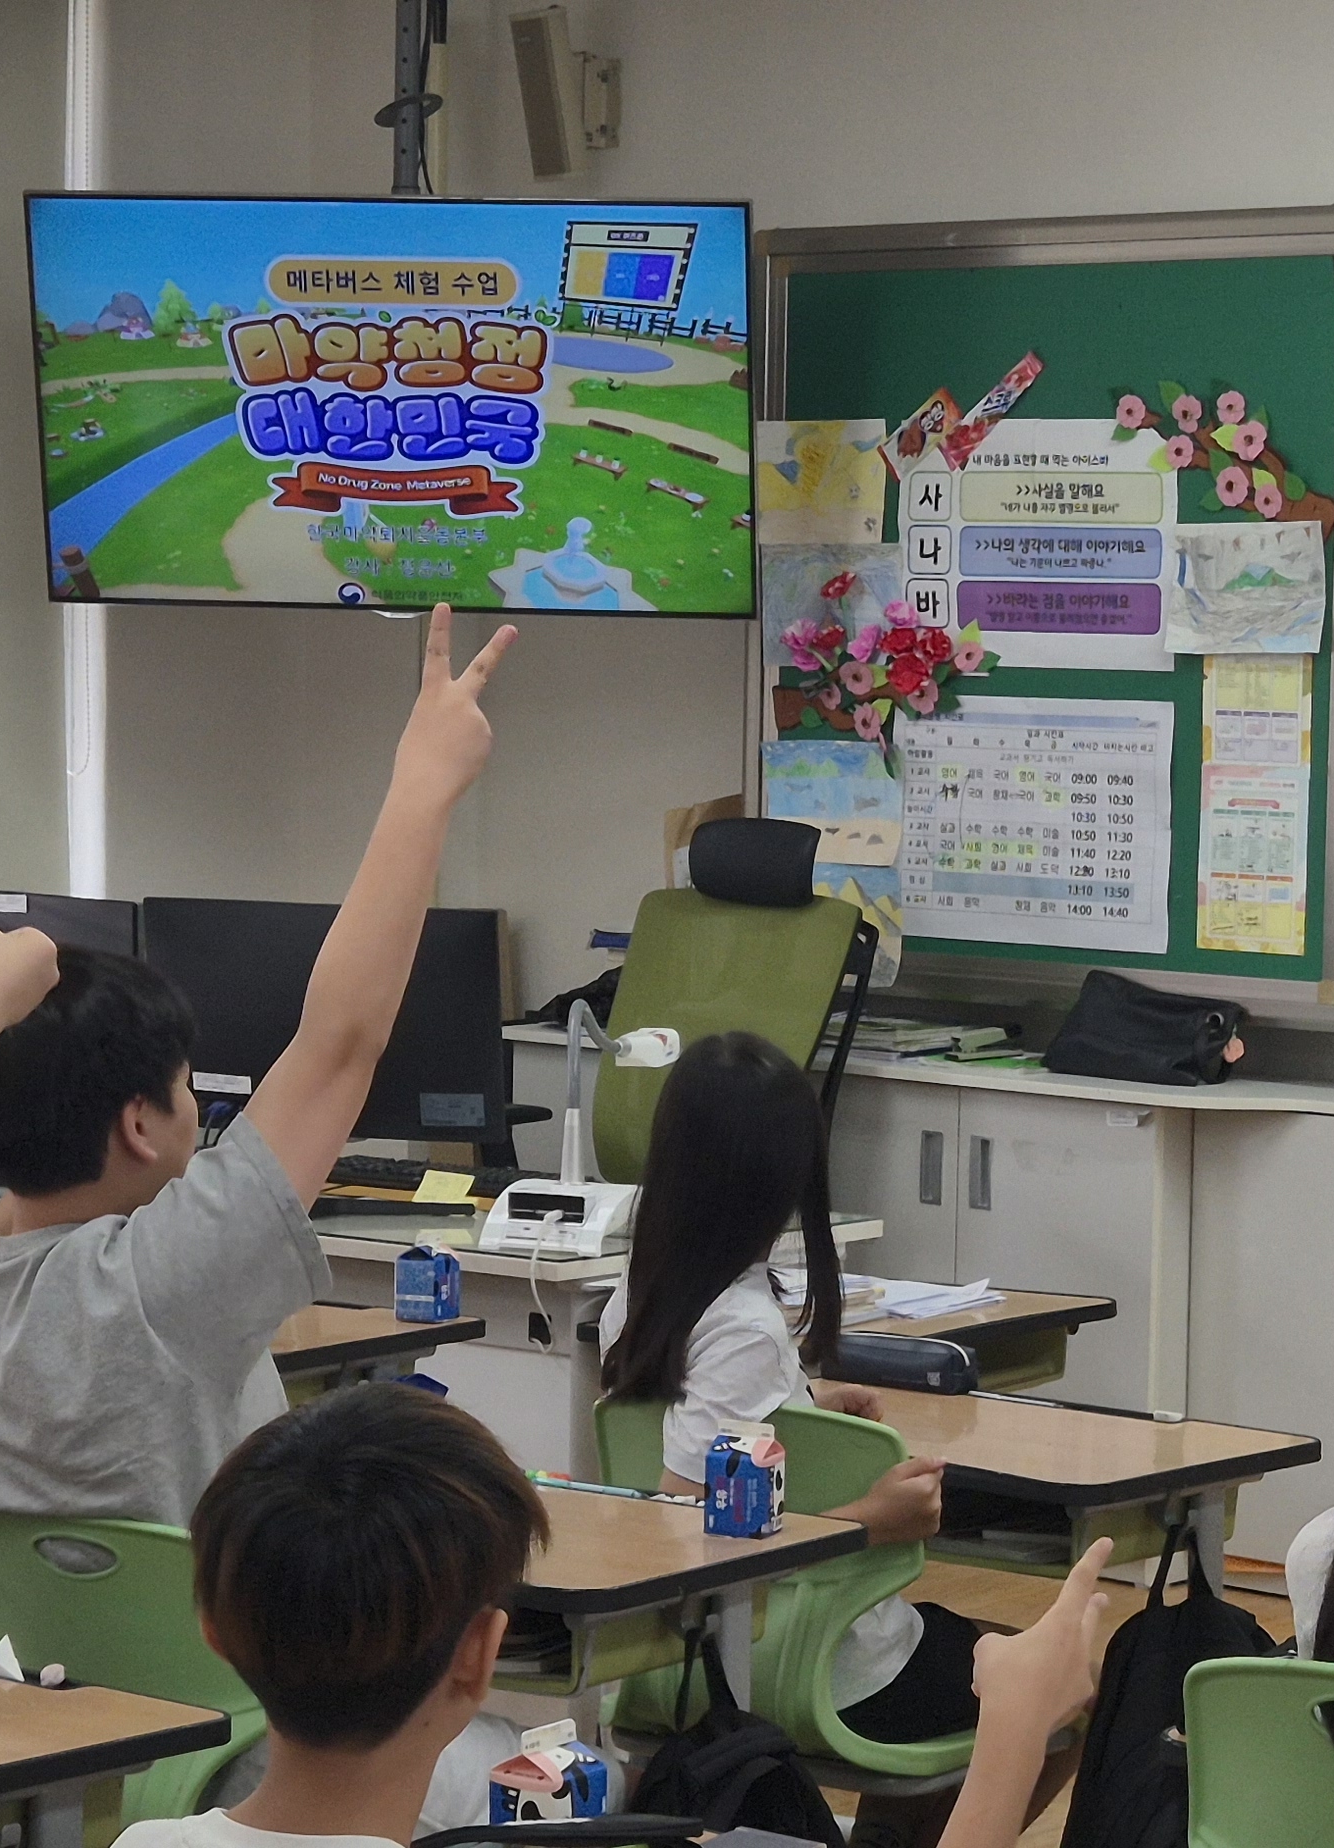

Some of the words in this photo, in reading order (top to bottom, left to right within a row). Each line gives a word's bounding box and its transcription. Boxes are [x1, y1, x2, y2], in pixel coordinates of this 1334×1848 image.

[286, 269, 383, 295] 메타버스
[394, 270, 440, 296] 체험
[451, 271, 499, 297] 수업
[231, 312, 550, 394] 마약청정
[242, 388, 540, 464] 대한민국
[984, 453, 1010, 467] 마음을
[317, 472, 336, 485] No
[338, 475, 369, 491] Drug
[370, 478, 402, 491] Zone
[405, 474, 472, 491] Metaverse
[918, 483, 943, 512] 사
[1068, 482, 1105, 500] 말해요
[919, 536, 942, 566] 나
[1018, 537, 1055, 555] 생각에
[1057, 538, 1083, 554] 대해
[1085, 538, 1147, 555] 이야기해요
[915, 590, 940, 619] 바
[1068, 593, 1131, 610] 이야기해요
[1107, 774, 1134, 787] 09:40
[1070, 792, 1097, 805] 09:50
[1108, 794, 1134, 806] 10:30
[1071, 811, 1097, 823] 10:30
[1107, 813, 1134, 825] 10:50
[1071, 829, 1097, 842] 10:50
[1107, 831, 1133, 843] 11:30
[1070, 847, 1096, 860] 11:40
[1107, 849, 1132, 861] 12:20
[1104, 886, 1130, 899] 13:50
[1067, 903, 1092, 916] 14:00
[1102, 906, 1129, 919] 14:40
